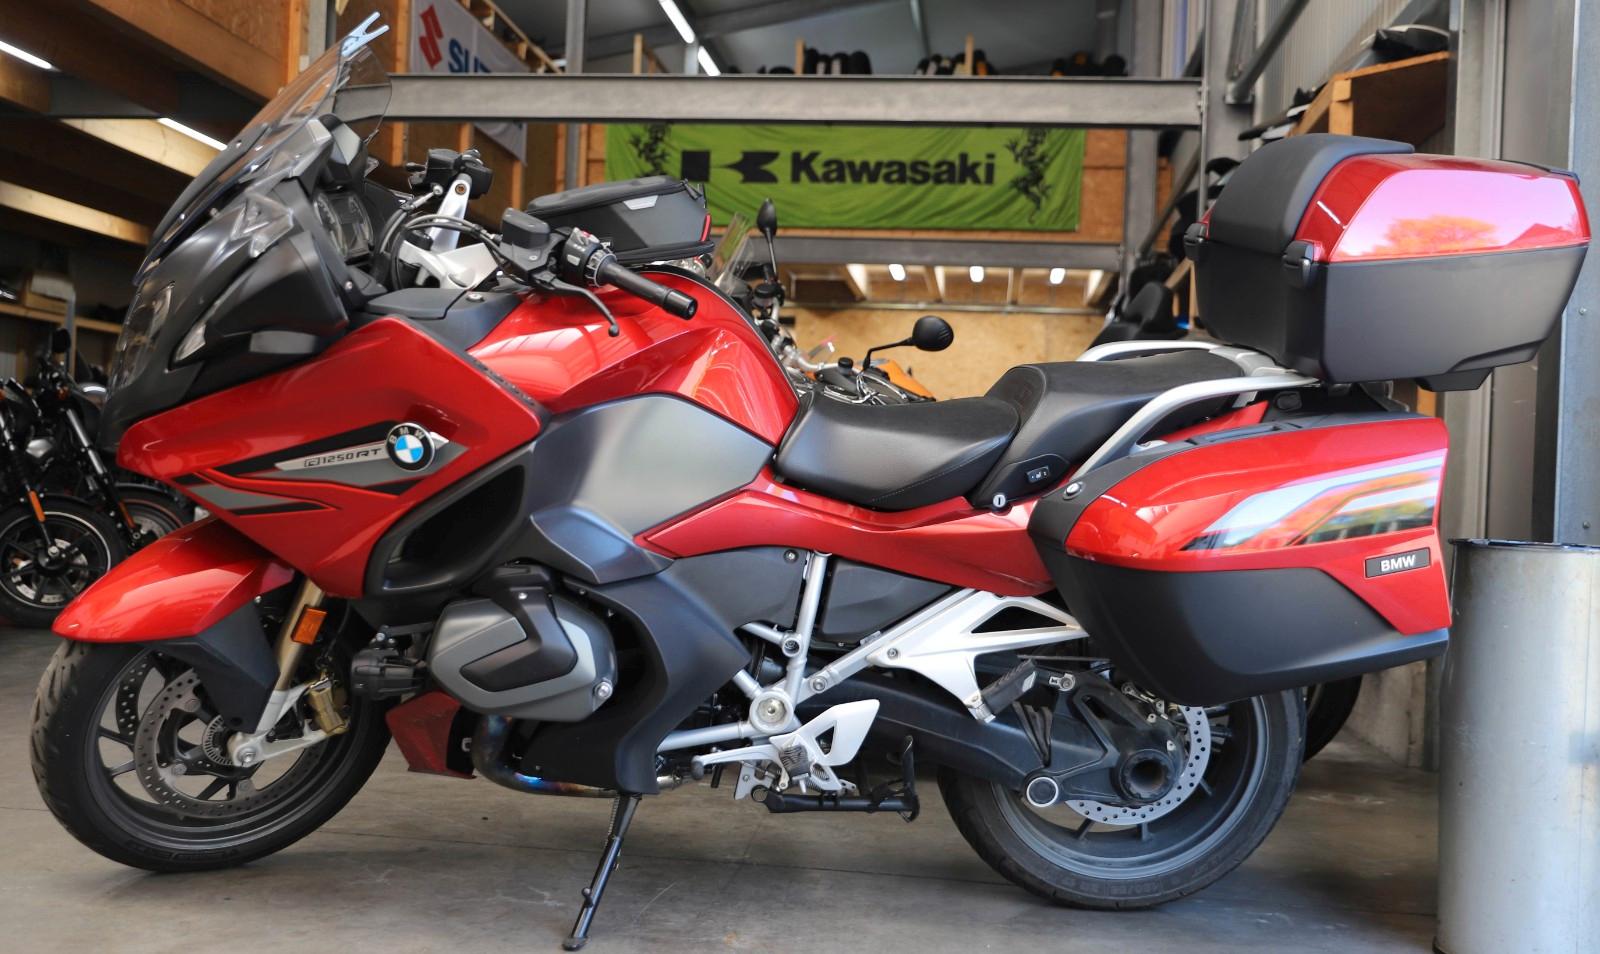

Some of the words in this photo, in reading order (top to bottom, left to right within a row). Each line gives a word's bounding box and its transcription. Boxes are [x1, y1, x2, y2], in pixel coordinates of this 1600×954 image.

[790, 151, 996, 186] Kawasaki
[389, 427, 425, 444] BMW
[1380, 555, 1416, 571] BMW
